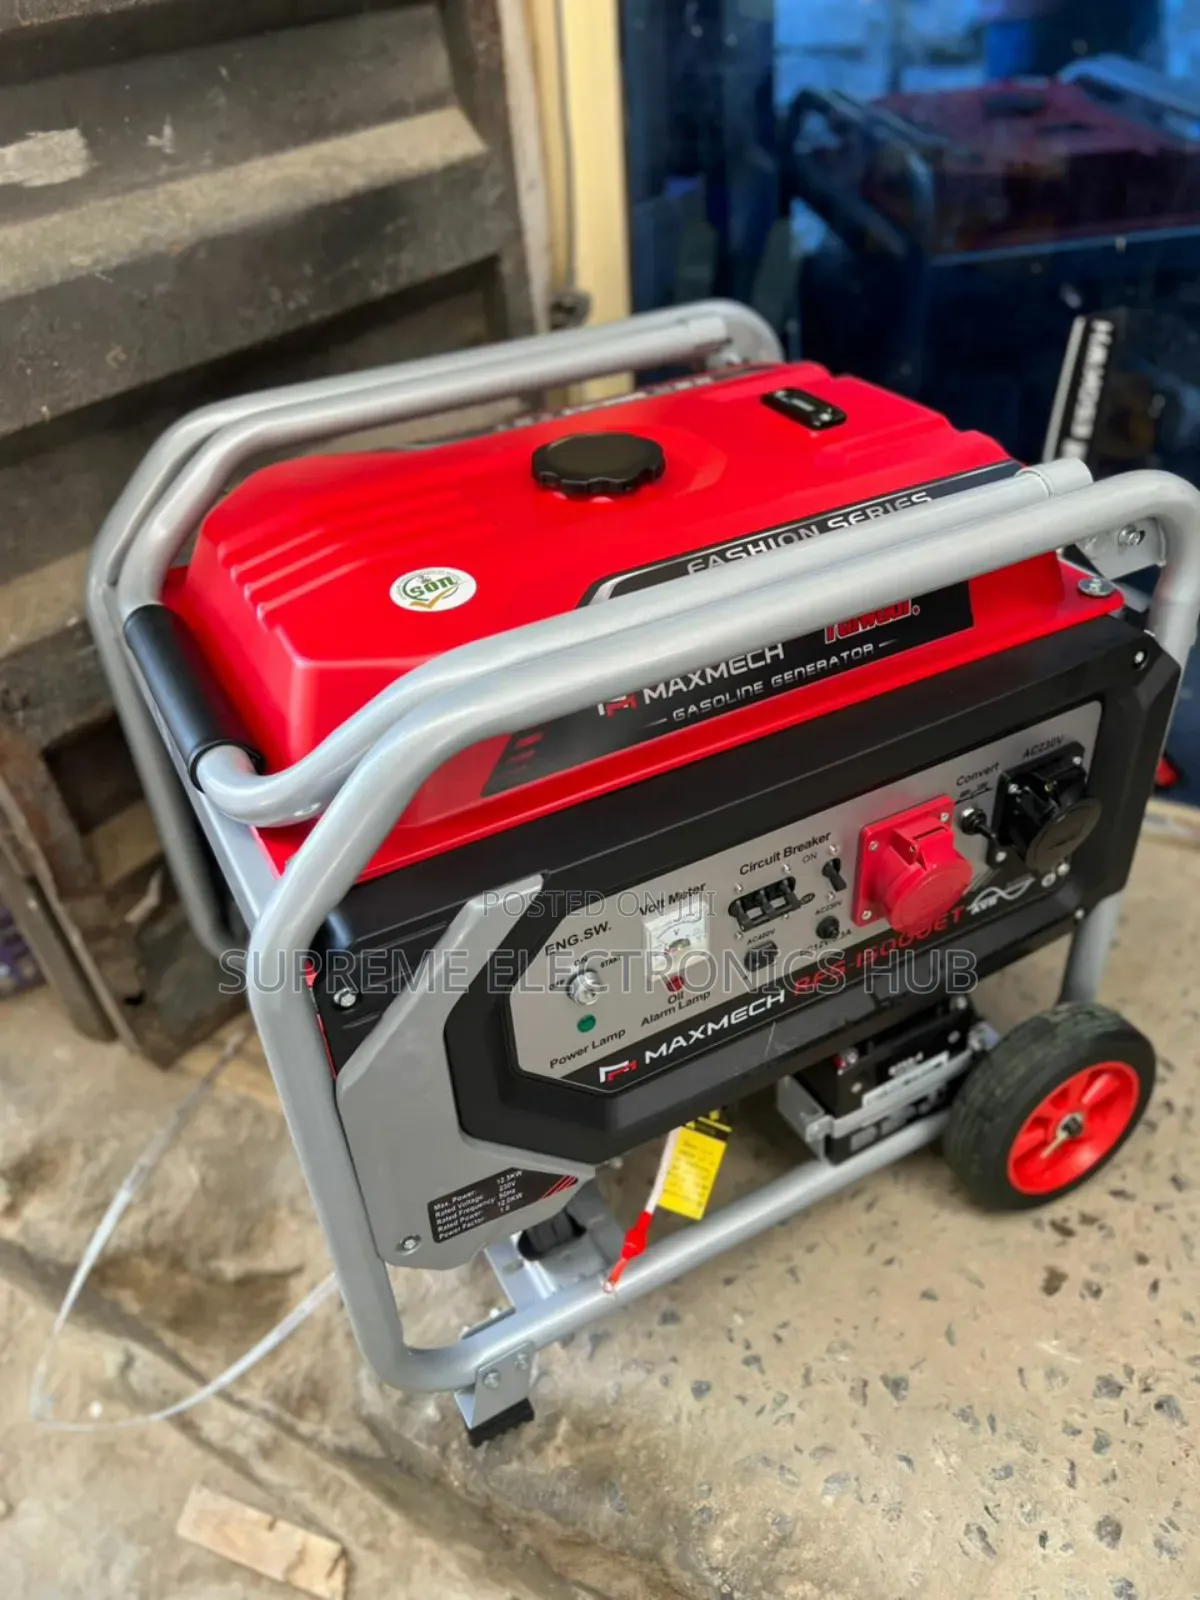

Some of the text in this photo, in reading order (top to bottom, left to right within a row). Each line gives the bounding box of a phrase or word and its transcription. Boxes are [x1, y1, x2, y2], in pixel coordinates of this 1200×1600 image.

[687, 491, 932, 575] FASHION SERIES
[643, 644, 785, 705] MAXMECH
[672, 642, 874, 722] GASOLINE GENERATOR
[956, 762, 999, 786] Convert
[739, 832, 831, 876] Circuit Breaker
[802, 852, 818, 864] ON
[639, 882, 706, 917] Volt Meter
[545, 921, 612, 957] ENG.SW.
[640, 991, 711, 1027] Alarm Lamp
[667, 991, 684, 1005] Oil
[644, 990, 786, 1065] MAXMECH
[549, 1028, 626, 1070] Power Lamp
[435, 1205, 456, 1218] Rated
[436, 1212, 457, 1225] Rated
[437, 1219, 458, 1232] Rated
[439, 1227, 461, 1239] Power
